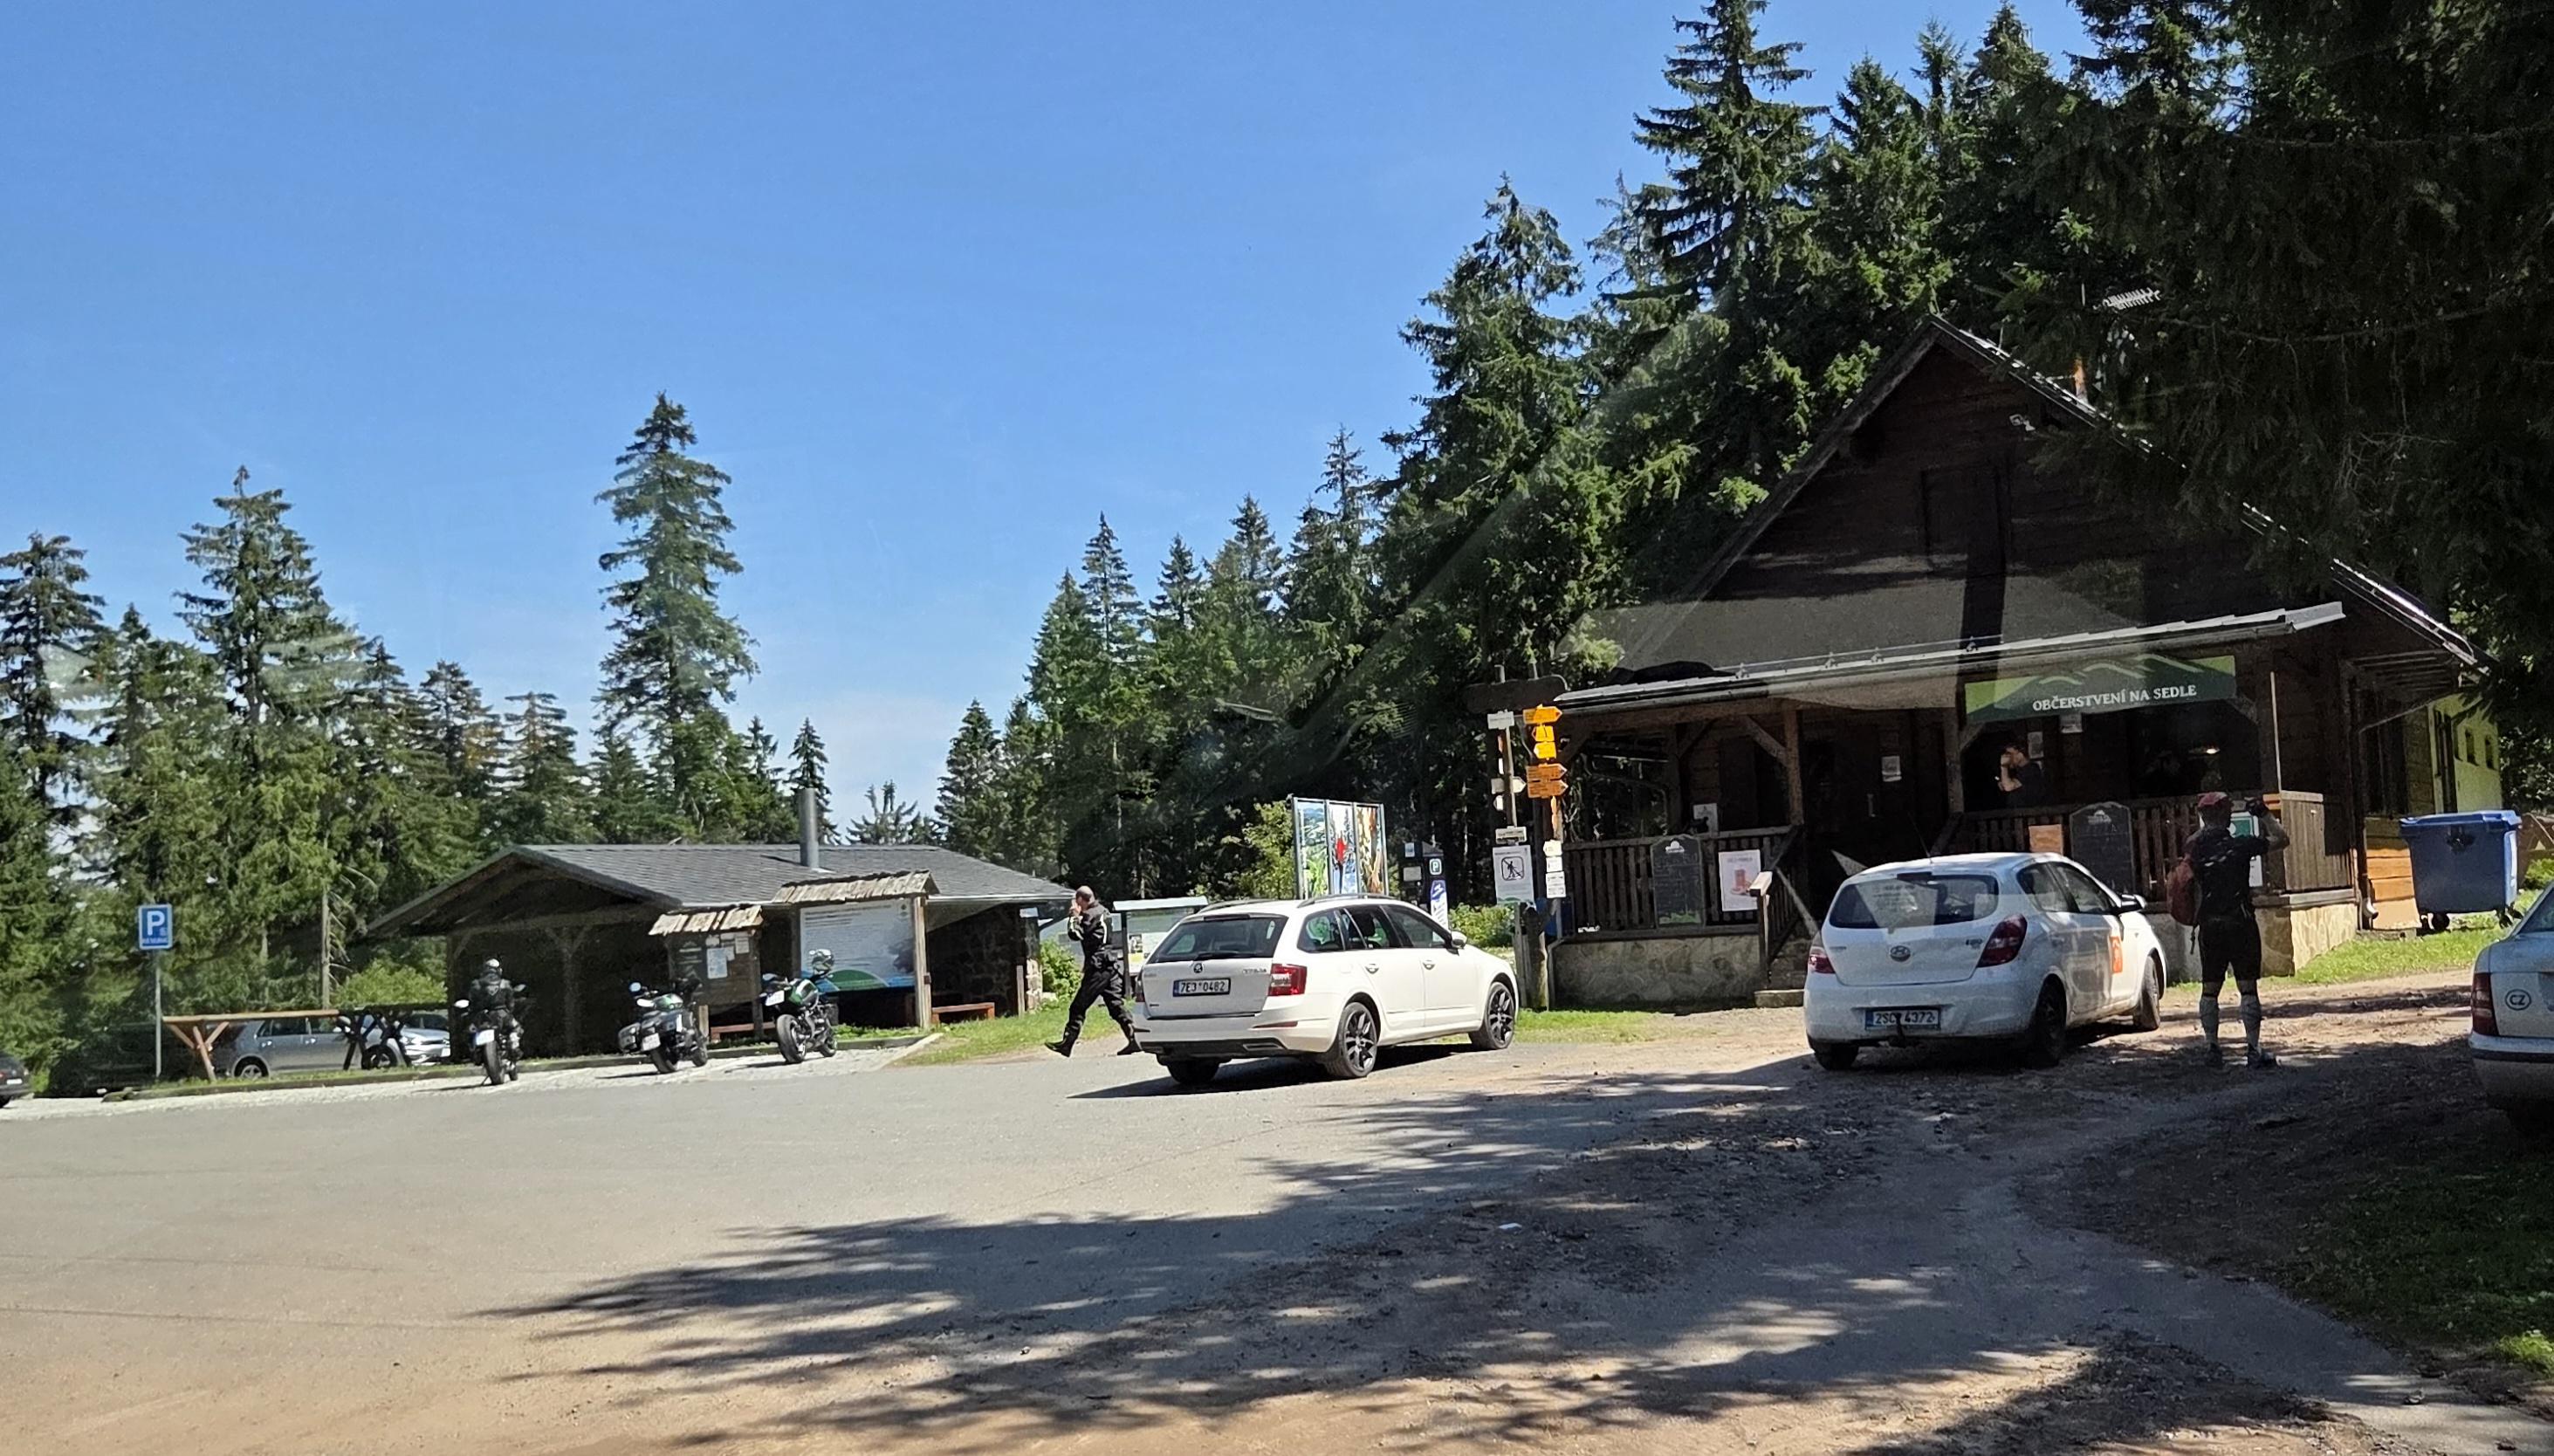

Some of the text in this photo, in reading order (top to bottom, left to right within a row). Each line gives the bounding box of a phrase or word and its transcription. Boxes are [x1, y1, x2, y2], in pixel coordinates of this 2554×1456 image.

[2032, 684, 2198, 711] OBČERSTVENÍ NA SEDLE
[147, 910, 166, 936] P
[2509, 994, 2526, 1006] CZ
